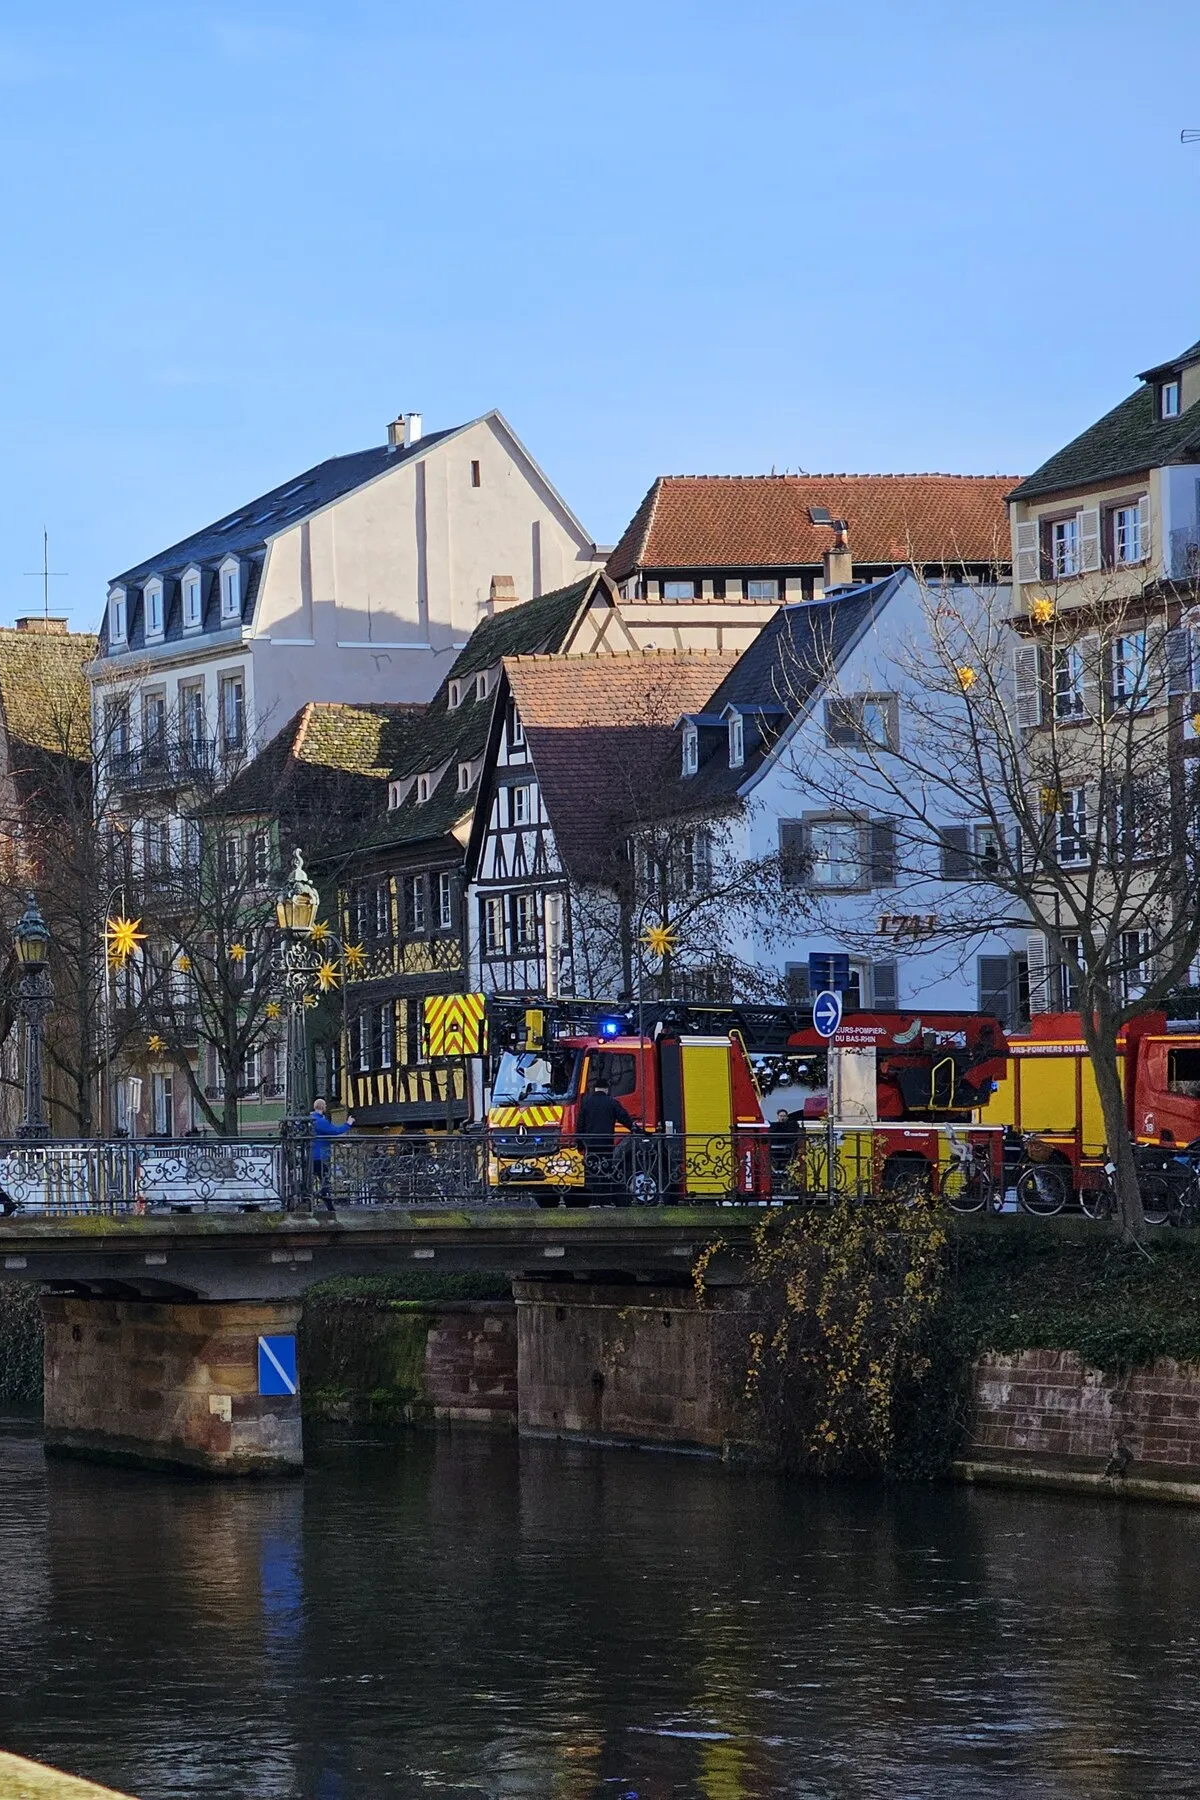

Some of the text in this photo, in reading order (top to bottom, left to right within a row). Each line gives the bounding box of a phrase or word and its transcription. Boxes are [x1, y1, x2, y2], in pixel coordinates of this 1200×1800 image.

[845, 1035, 876, 1043] BAS-RHIN
[1063, 1045, 1074, 1053] DU
[1145, 1123, 1154, 1132] 18
